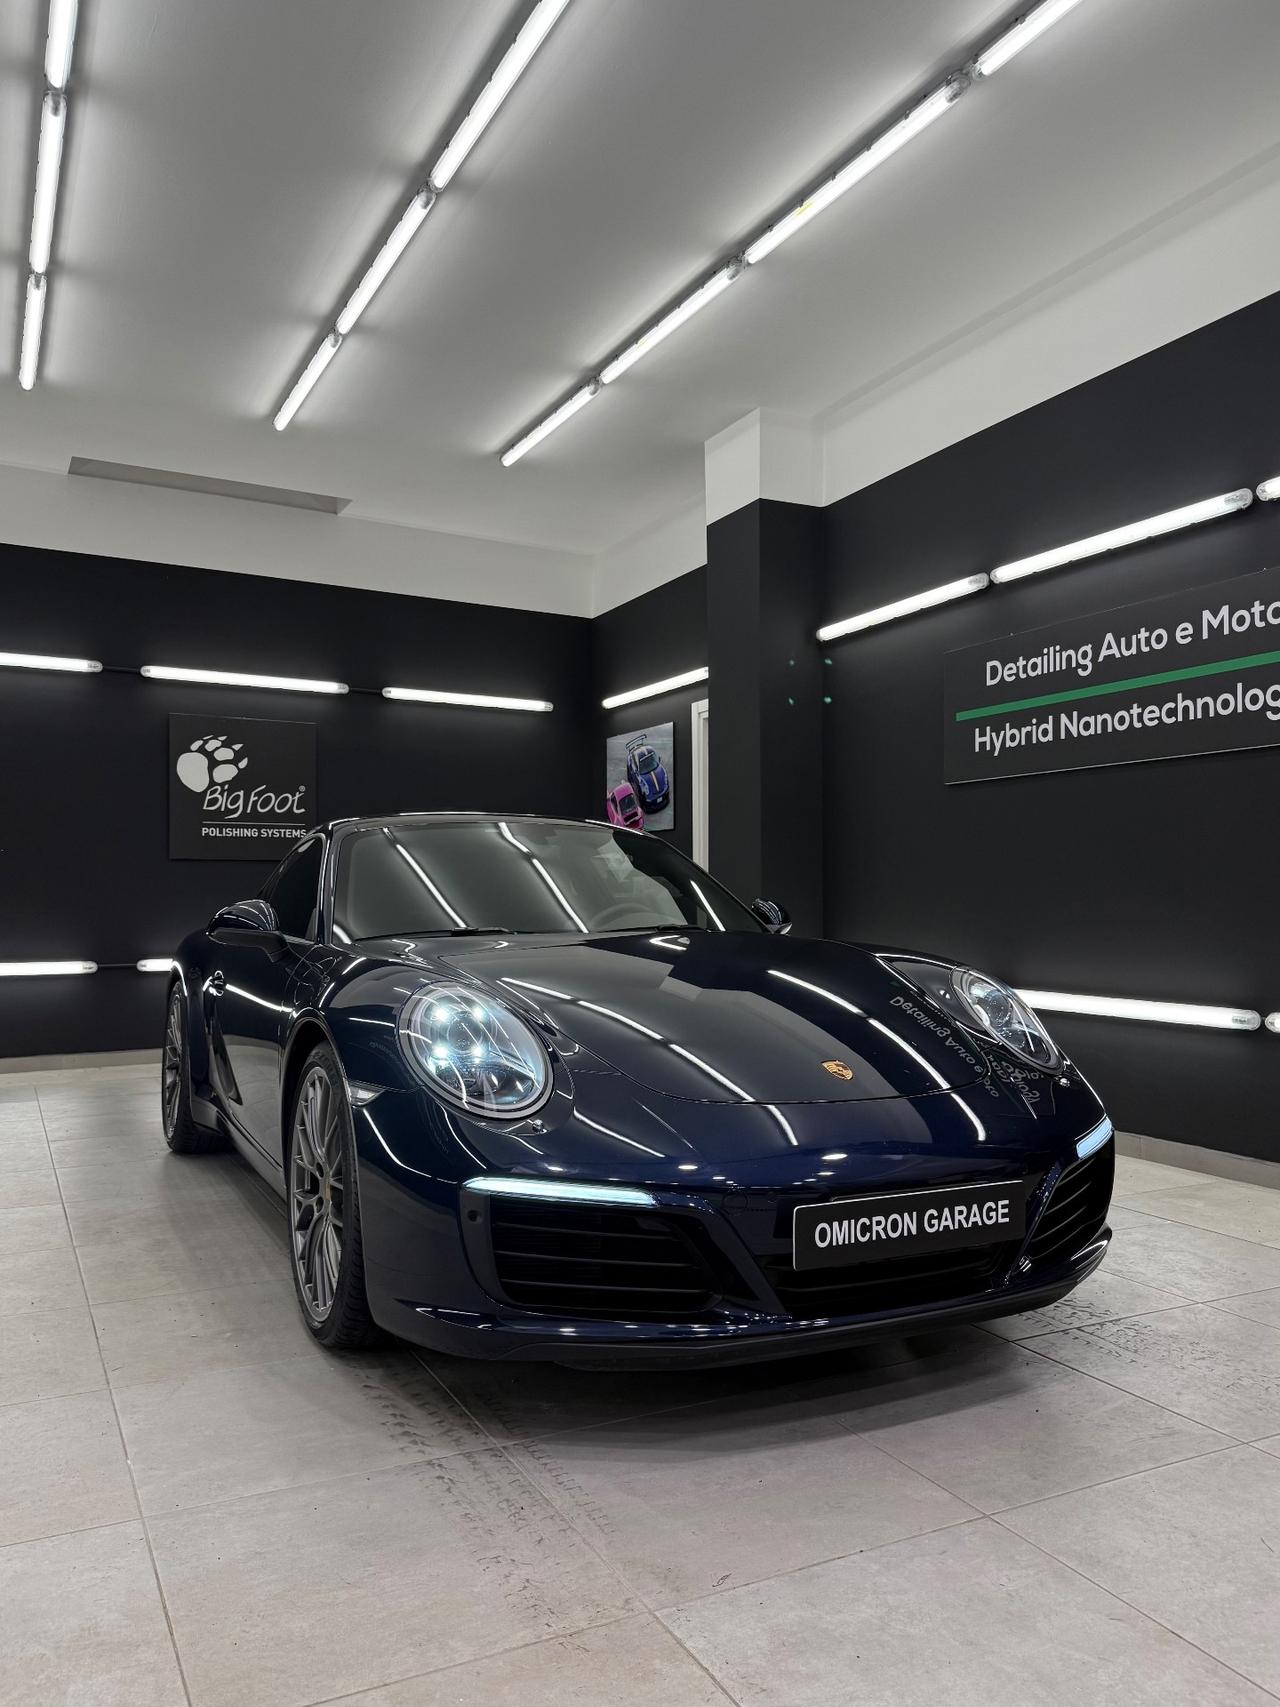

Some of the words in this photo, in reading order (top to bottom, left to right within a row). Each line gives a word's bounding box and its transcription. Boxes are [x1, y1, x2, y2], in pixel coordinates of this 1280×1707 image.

[987, 643, 1092, 686] Detailing
[1098, 627, 1168, 662] Auto
[1175, 622, 1194, 645] e
[1202, 600, 1280, 640] Moto
[974, 716, 1053, 756] Hybrid
[1060, 682, 1280, 740] Nanotechnolog
[202, 827, 258, 837] POLISHING
[260, 828, 307, 838] SYSTEMS
[814, 1211, 917, 1248] OMICRON
[924, 1199, 1010, 1233] GARAGE
